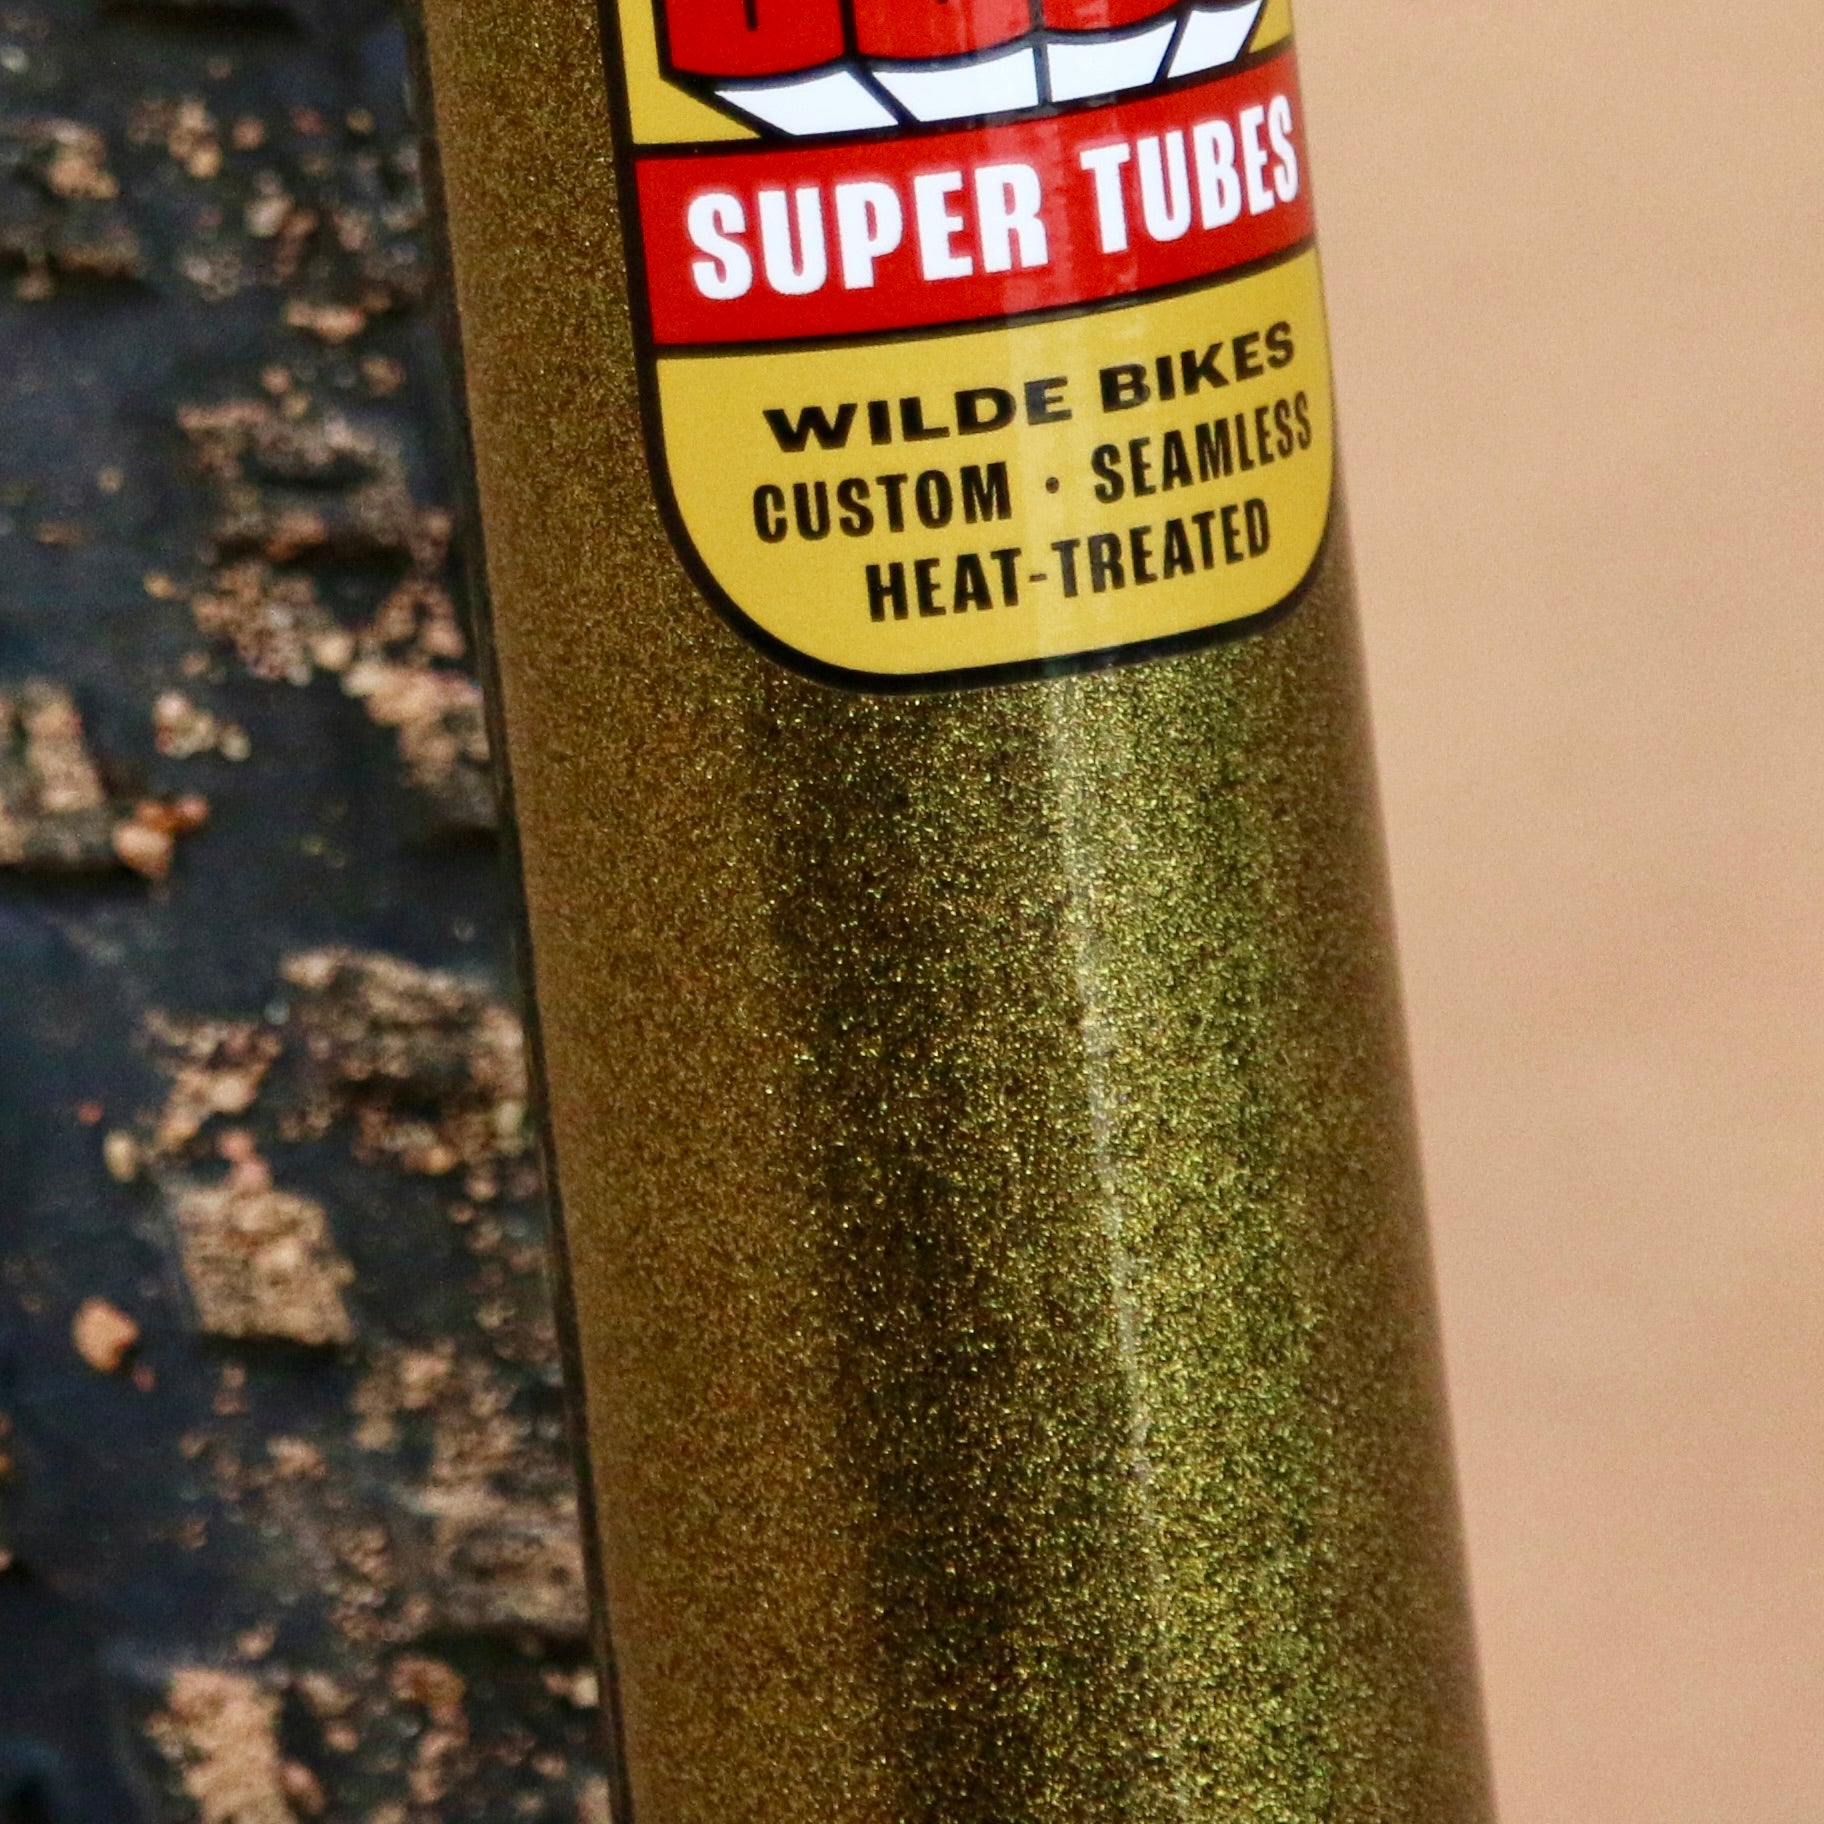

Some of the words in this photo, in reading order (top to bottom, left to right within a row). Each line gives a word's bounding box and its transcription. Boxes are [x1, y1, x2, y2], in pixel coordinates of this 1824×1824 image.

[687, 162, 1048, 300] SUPER
[1080, 94, 1300, 254] TUBES
[763, 377, 1073, 453] WILDE
[1100, 321, 1295, 413] BIKES
[753, 462, 1012, 543] CUSTOM
[1093, 391, 1313, 504] SEAMLESS
[865, 498, 1271, 623] HEAT-TREATED
